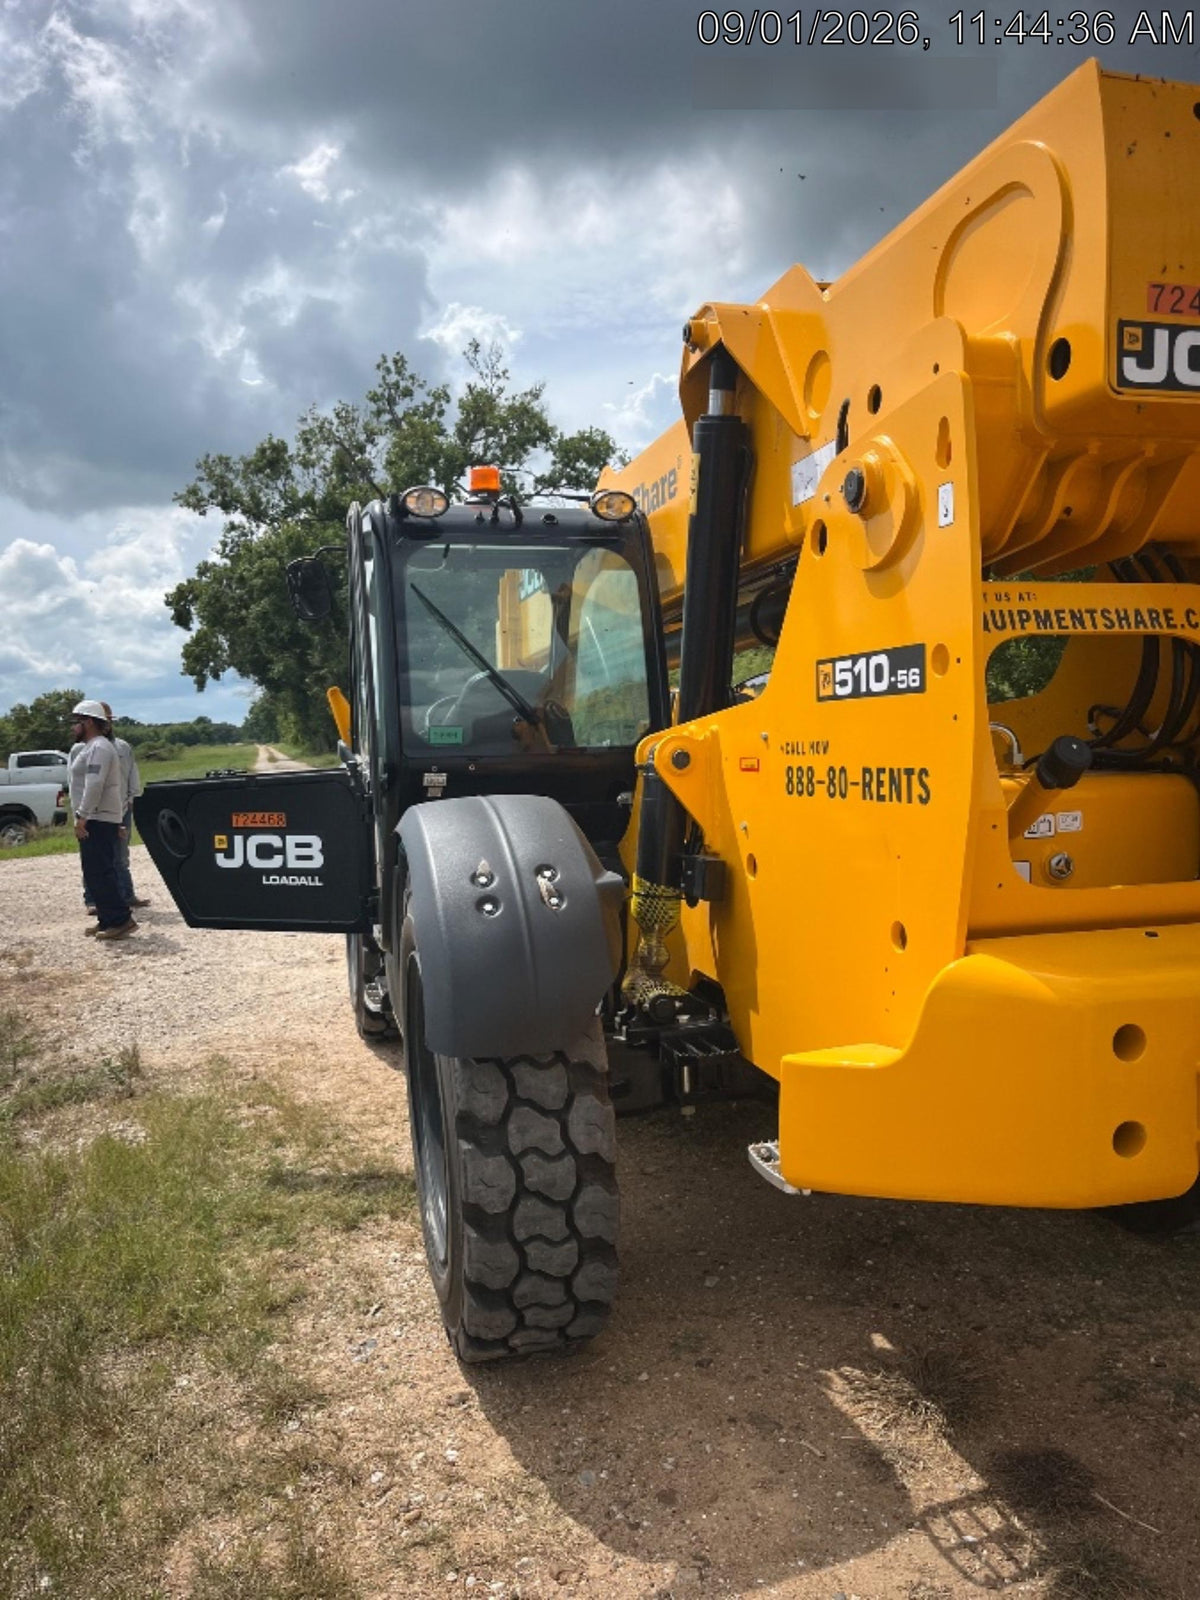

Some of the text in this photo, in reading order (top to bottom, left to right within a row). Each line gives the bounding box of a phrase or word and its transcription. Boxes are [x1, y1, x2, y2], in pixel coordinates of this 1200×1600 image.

[994, 592, 1010, 602] US
[785, 740, 829, 755] CALL NOW
[786, 766, 931, 805] 888-80-RENTS
[215, 835, 324, 868] JCB
[262, 875, 323, 886] LOADALL
